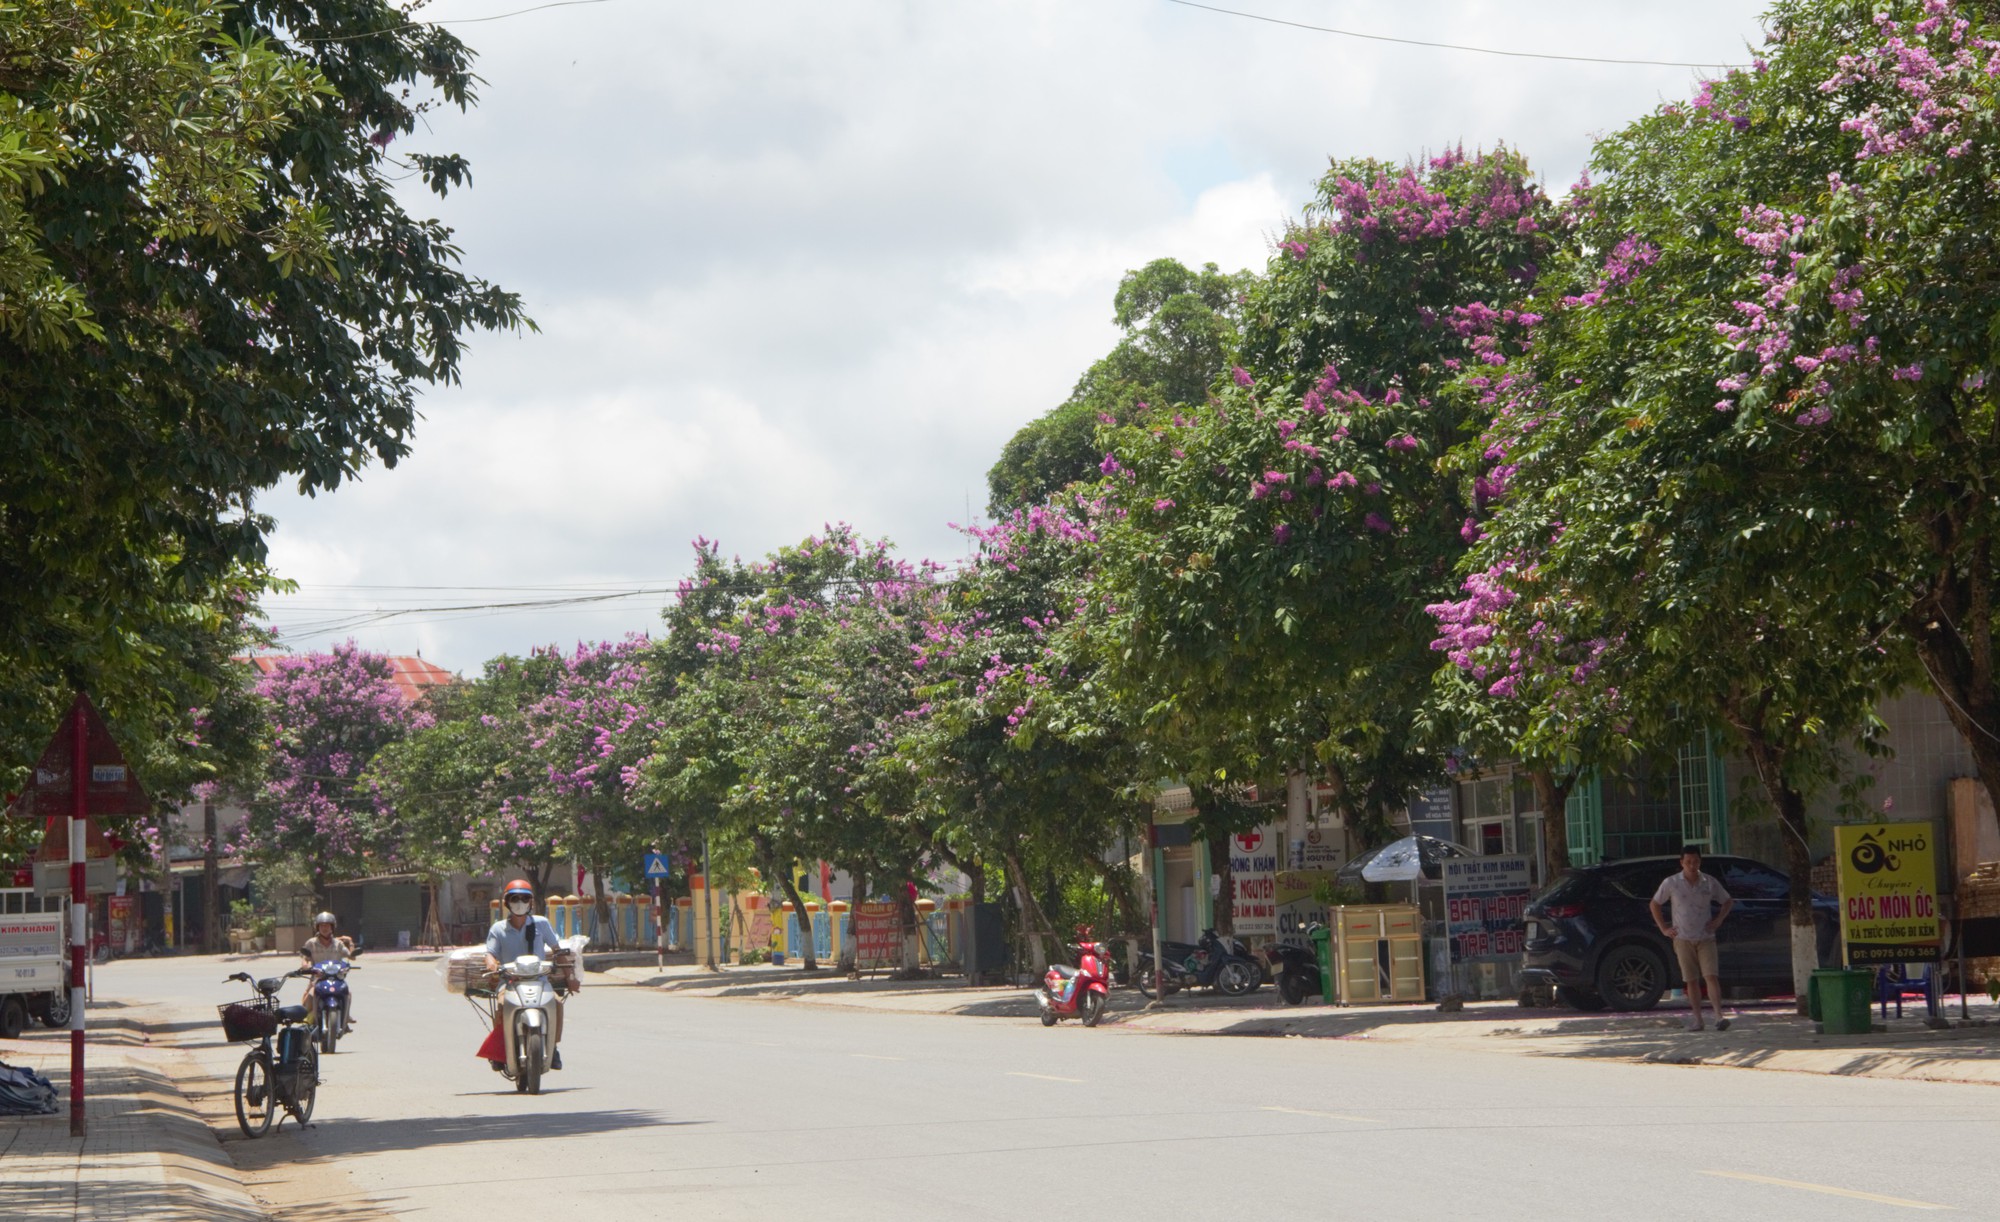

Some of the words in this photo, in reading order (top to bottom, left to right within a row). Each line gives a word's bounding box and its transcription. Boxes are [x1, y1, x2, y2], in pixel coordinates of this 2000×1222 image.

[1851, 828, 1901, 874] Ốc
[1888, 834, 1926, 852] NHỎ
[1231, 855, 1250, 872] HÒNG
[1253, 854, 1275, 872] KHÁM
[1449, 863, 1461, 876] NỘI
[1463, 860, 1480, 874] THẤT
[1483, 862, 1498, 873] KIM
[1500, 859, 1525, 872] KHÁNH
[1241, 902, 1251, 917] ÂM
[1449, 893, 1481, 923] BÁN
[1848, 892, 1875, 920] CÁC
[1879, 890, 1911, 919] MÓN
[1915, 886, 1933, 918] ỐC
[1, 926, 20, 934] KIM
[1850, 925, 1861, 939] VÀ
[1885, 922, 1906, 938] UỐNG
[1908, 926, 1916, 937] ĐI
[1918, 923, 1935, 936] KÈM
[1457, 928, 1489, 957] TRẢ
[1853, 950, 1868, 959] ĐT:
[1870, 949, 1895, 958] 0975
[1897, 948, 1915, 957] 676
[1918, 947, 1936, 956] 365
